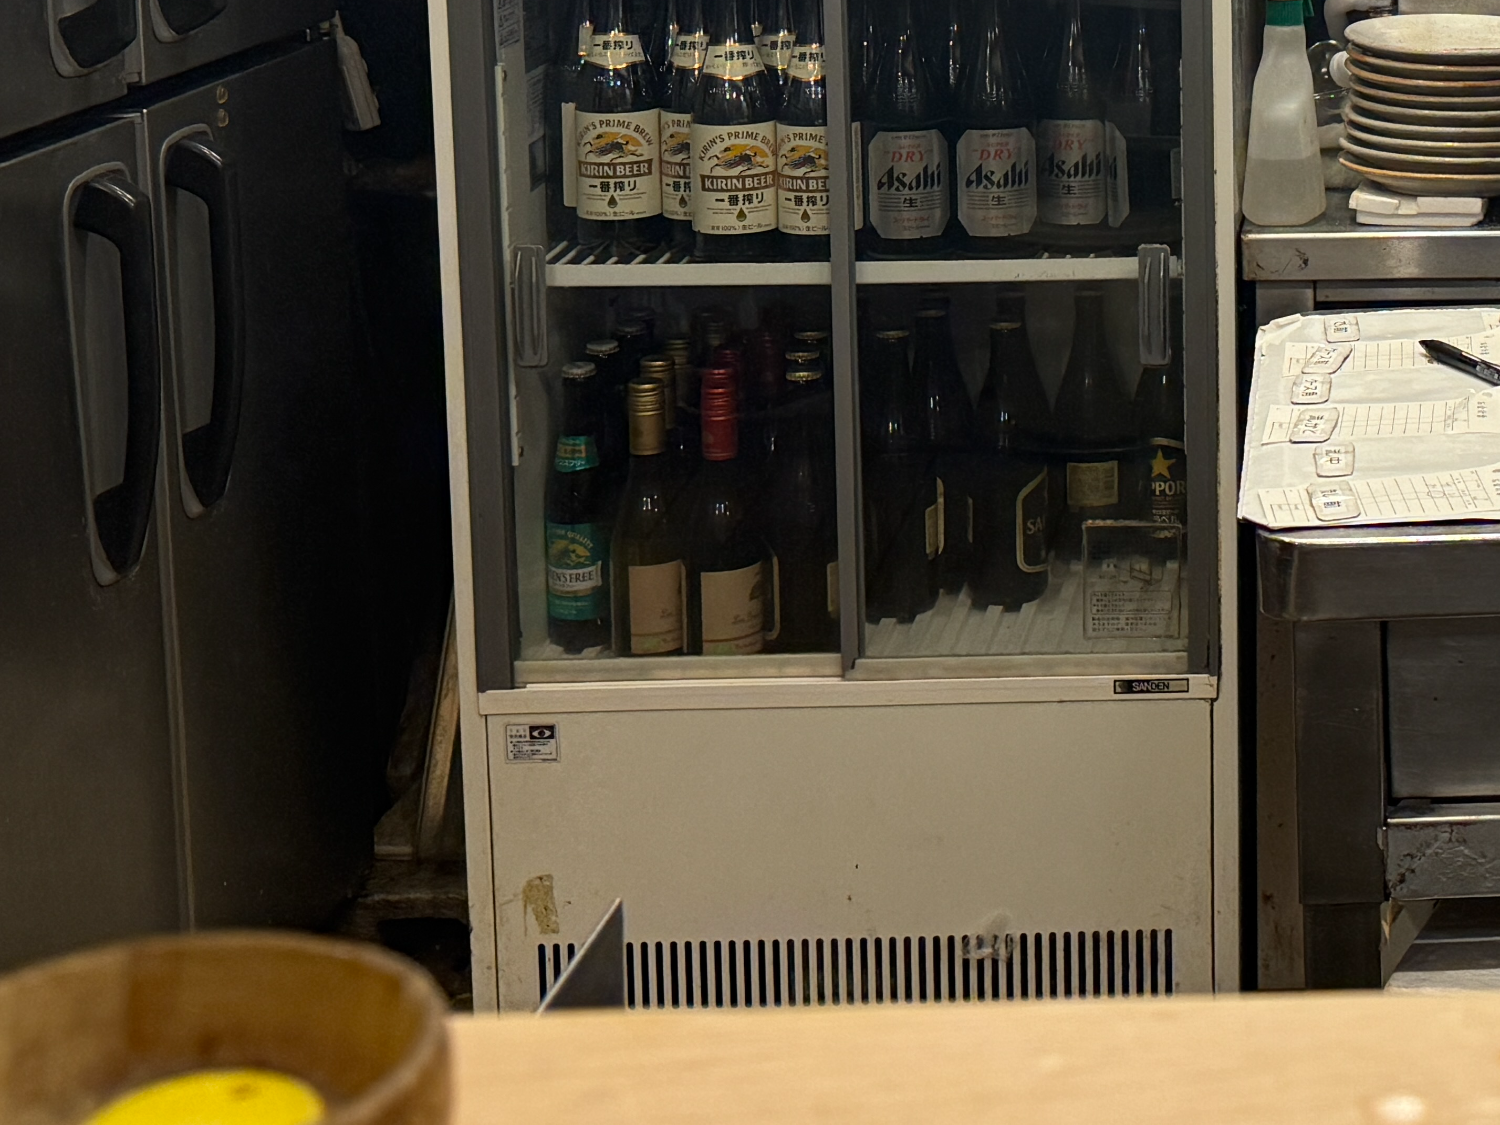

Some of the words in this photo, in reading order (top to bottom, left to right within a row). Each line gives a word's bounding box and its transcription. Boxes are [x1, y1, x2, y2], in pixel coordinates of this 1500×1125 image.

[593, 40, 633, 51] 一番搾り
[714, 50, 755, 62] 一番搾り
[599, 119, 632, 131] PRIME
[633, 124, 654, 147] BREW
[792, 132, 825, 144] PRIME
[699, 134, 725, 162] KIRIN'S
[727, 130, 760, 141] PRIME
[890, 150, 926, 163] DRY
[977, 148, 1014, 161] DRY
[581, 165, 614, 177] KIRIN
[616, 163, 649, 176] BEER
[1042, 151, 1101, 180] Asahi
[877, 161, 942, 192] Asahi
[965, 159, 1029, 190] Asahi
[588, 180, 637, 193] 一番搾り
[705, 177, 743, 189] KIRIN
[745, 174, 773, 188] BEER
[715, 192, 764, 207] 一番搾り
[784, 194, 829, 207] 一番搾り
[903, 197, 919, 208] 生
[991, 195, 1007, 206] 生
[569, 570, 594, 583] FREE
[1132, 682, 1170, 692] SANDEN
